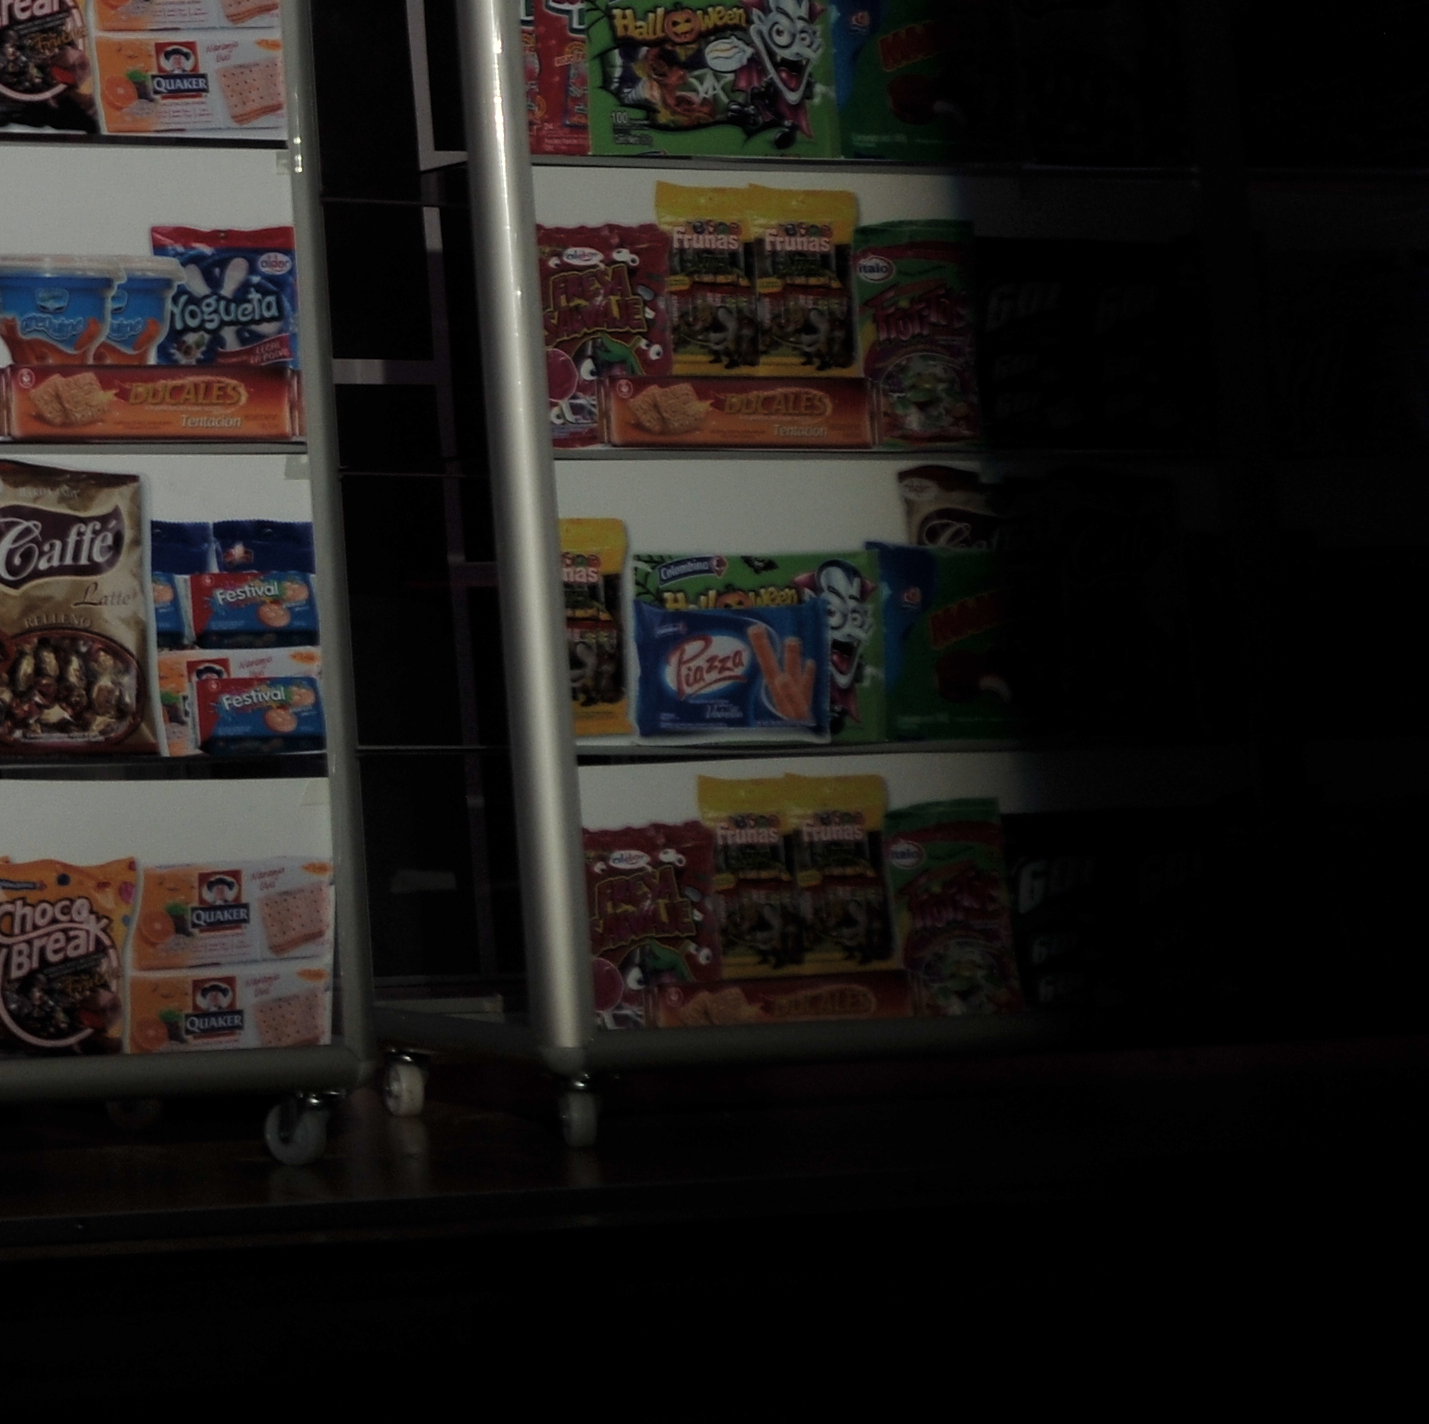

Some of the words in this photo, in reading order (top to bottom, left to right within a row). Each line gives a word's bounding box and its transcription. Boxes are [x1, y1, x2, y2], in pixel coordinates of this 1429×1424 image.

[153, 77, 209, 92] QUAKER
[171, 290, 280, 330] Yogueta
[129, 381, 242, 405] DUCALES
[215, 583, 280, 603] Festival
[668, 635, 747, 698] Piazza
[192, 906, 248, 924] QUAKER
